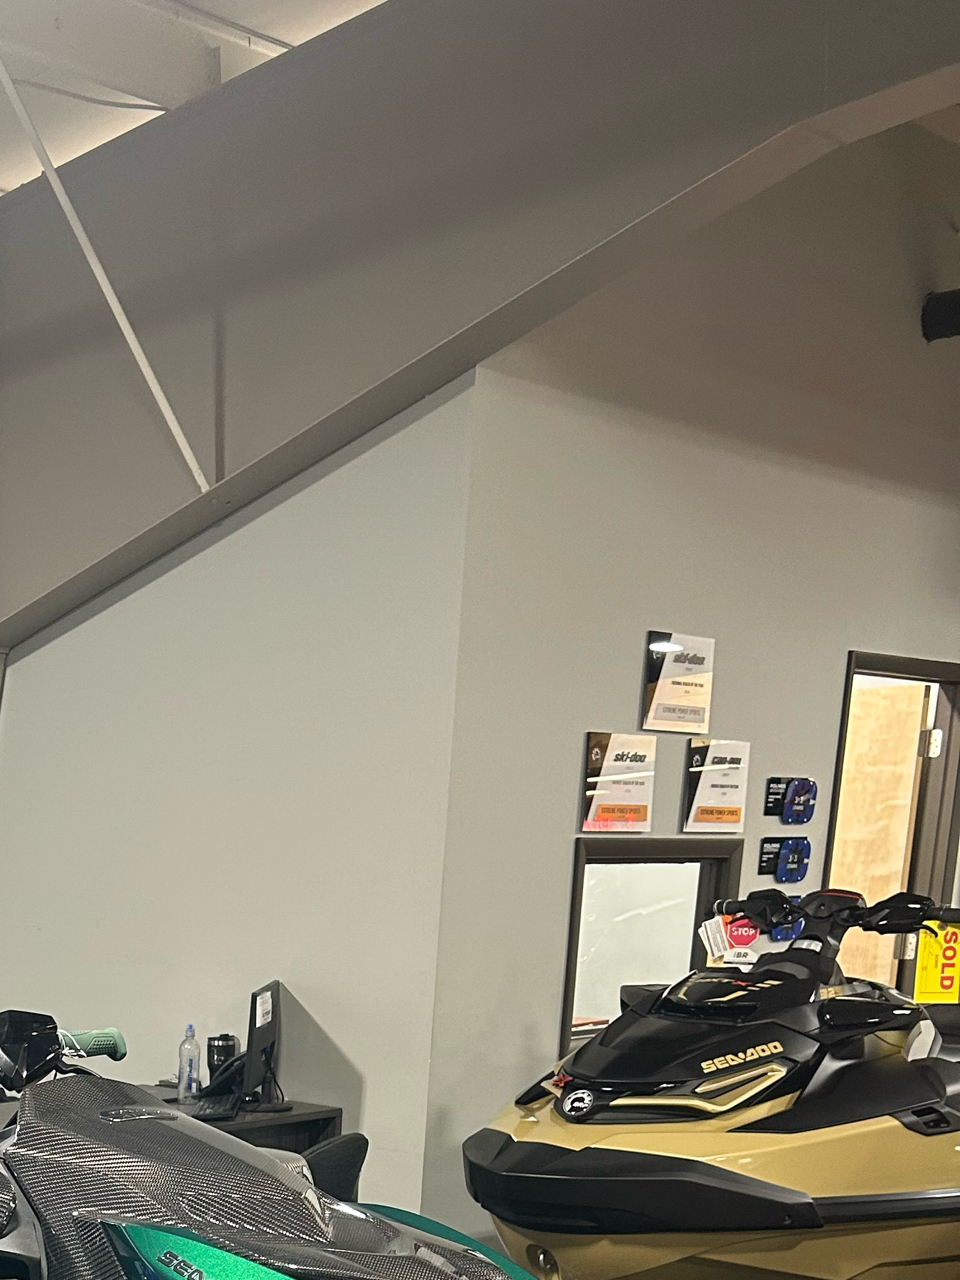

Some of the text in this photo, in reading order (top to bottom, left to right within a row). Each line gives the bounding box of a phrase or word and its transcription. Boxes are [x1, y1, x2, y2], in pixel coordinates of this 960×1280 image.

[613, 751, 647, 762] ski-doo
[732, 927, 756, 936] STOP
[940, 930, 959, 990] SOLD
